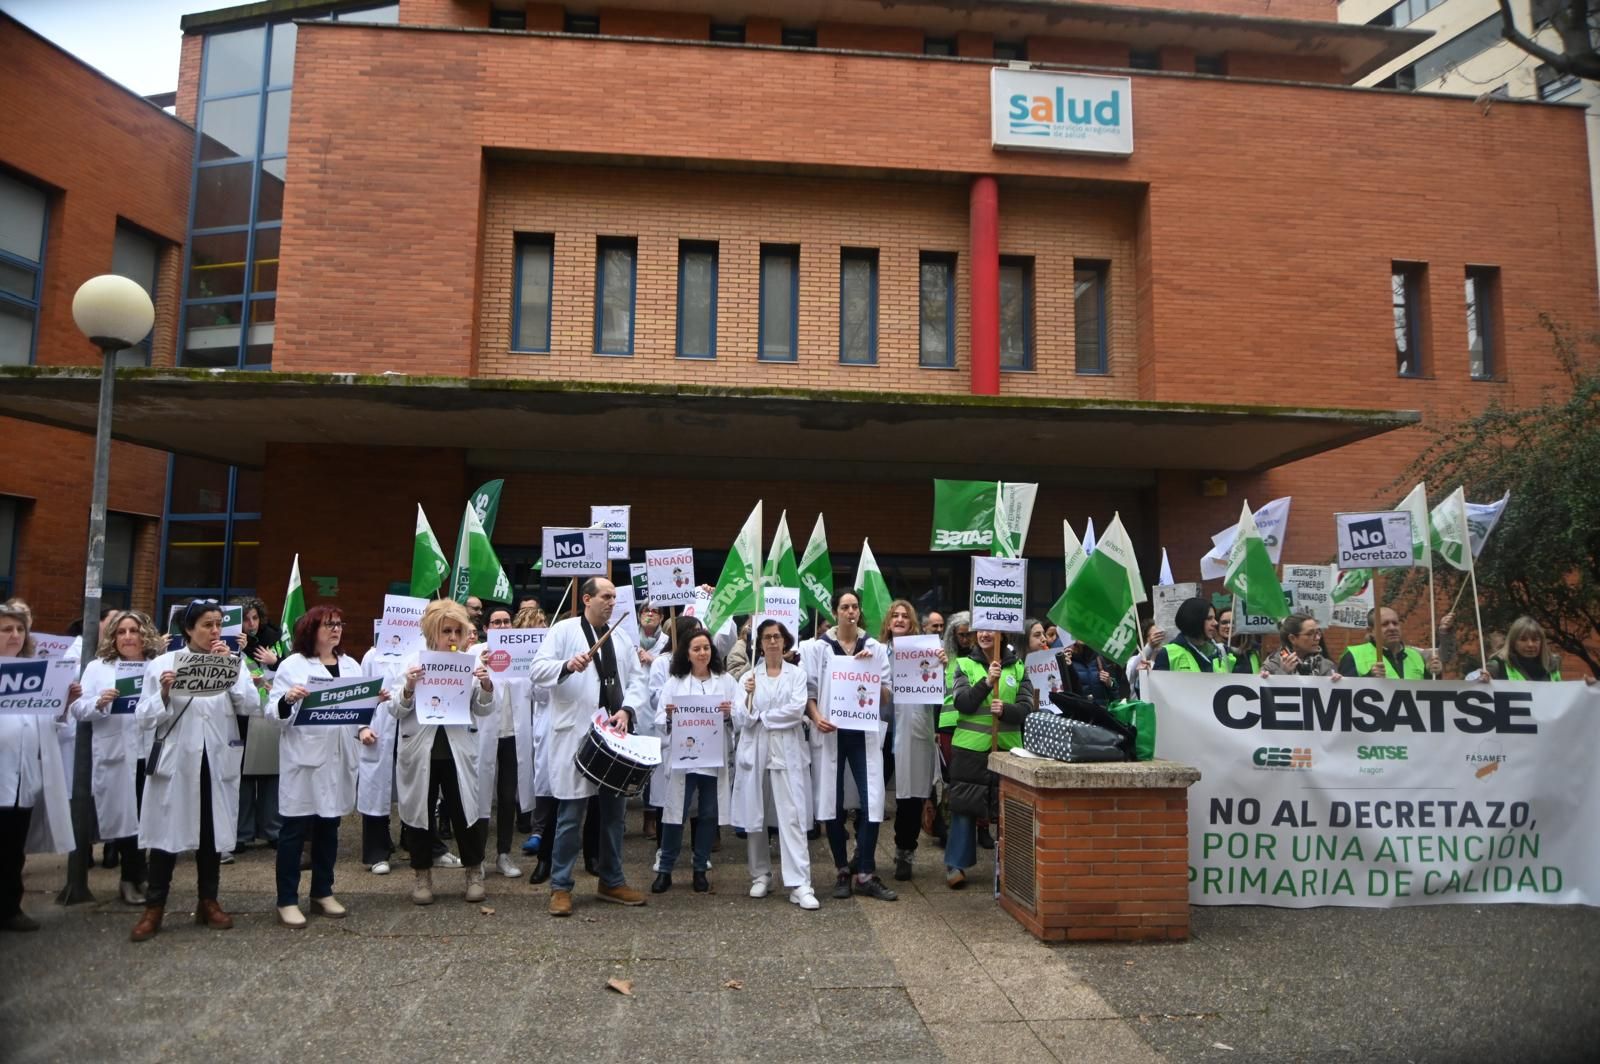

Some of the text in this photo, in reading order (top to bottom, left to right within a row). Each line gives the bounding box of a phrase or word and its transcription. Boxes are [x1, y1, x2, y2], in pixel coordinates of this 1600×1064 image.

[1009, 86, 1120, 126] salud
[1352, 529, 1384, 548] No
[555, 541, 584, 557] No
[1388, 542, 1396, 550] al
[648, 554, 693, 567] ENGAÑO
[1342, 550, 1408, 561] Decretazo
[546, 559, 602, 569] Decretazo
[976, 576, 1016, 588] Respeto
[651, 591, 696, 602] POBLACIÓN
[765, 597, 797, 605] ROPELLO
[975, 593, 1022, 606] Condiciones
[386, 606, 425, 615] ATROPELL
[986, 610, 1019, 624] trabajo
[1245, 614, 1275, 626] Labo
[500, 633, 546, 645] RESPET
[895, 648, 941, 661] ENGAÑO
[421, 664, 471, 673] ATROPELLO
[1027, 660, 1057, 674] NGAÑ
[422, 677, 465, 687] LABORAL
[832, 670, 880, 683] ENGAÑO
[0, 672, 42, 694] No
[894, 684, 943, 694] POBLACIÓN
[320, 686, 370, 702] Engaño
[0, 697, 62, 709] cretazo
[1213, 684, 1538, 734] CEMSATSE
[309, 710, 360, 721] Población
[674, 706, 721, 715] ATROPELLO
[831, 708, 878, 721] POBLACIÓN
[677, 719, 717, 728] LABORAL
[1357, 745, 1409, 760] SATSE
[1465, 754, 1507, 763] FASAMET
[1209, 797, 1537, 831] NO AL DECRETAZO,
[1203, 828, 1540, 863] POR UNA ATENCIÓN
[1367, 868, 1412, 898] DE
[1423, 865, 1563, 897] CALIDAD
